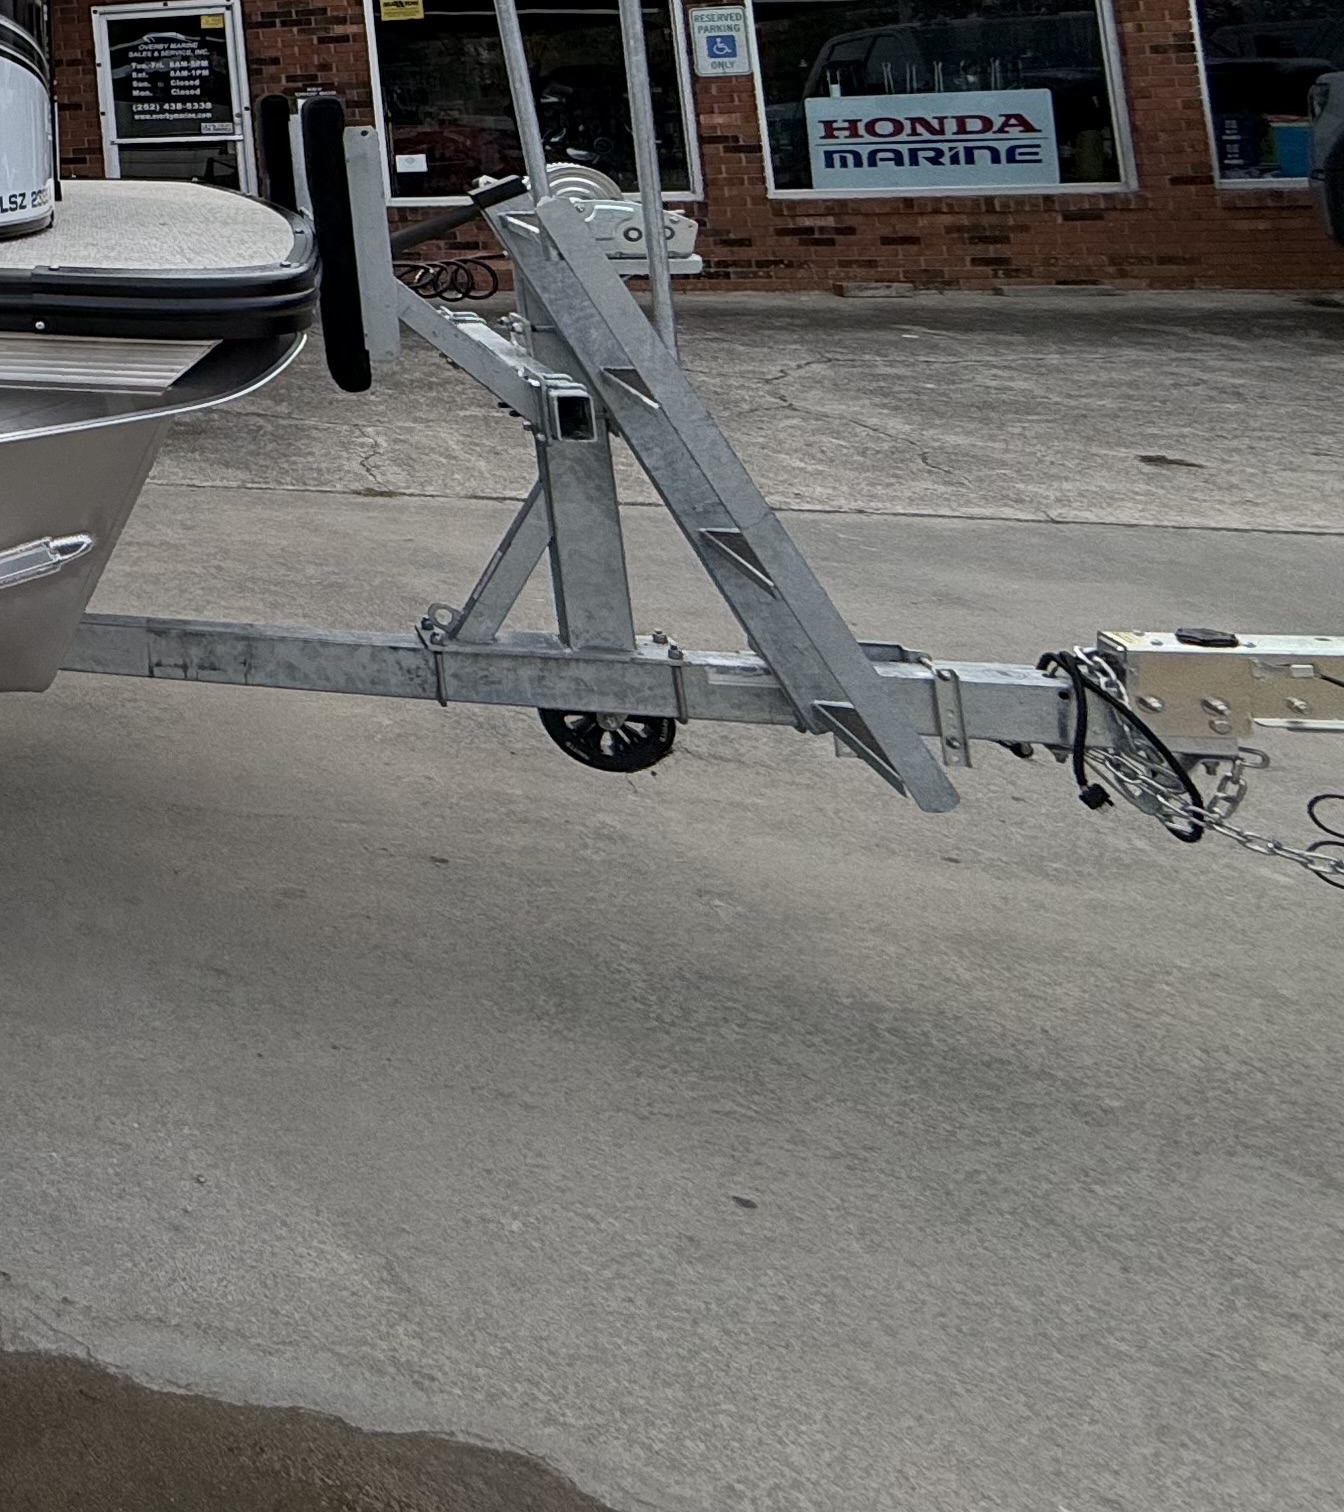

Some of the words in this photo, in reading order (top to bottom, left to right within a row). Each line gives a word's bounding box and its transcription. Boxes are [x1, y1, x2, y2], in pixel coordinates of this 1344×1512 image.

[693, 12, 742, 23] RESERVED
[697, 23, 741, 34] PARKING
[710, 60, 736, 71] ONLY
[818, 113, 1042, 140] HONDA
[823, 144, 1044, 170] MARINE
[0, 192, 27, 214] LSZ
